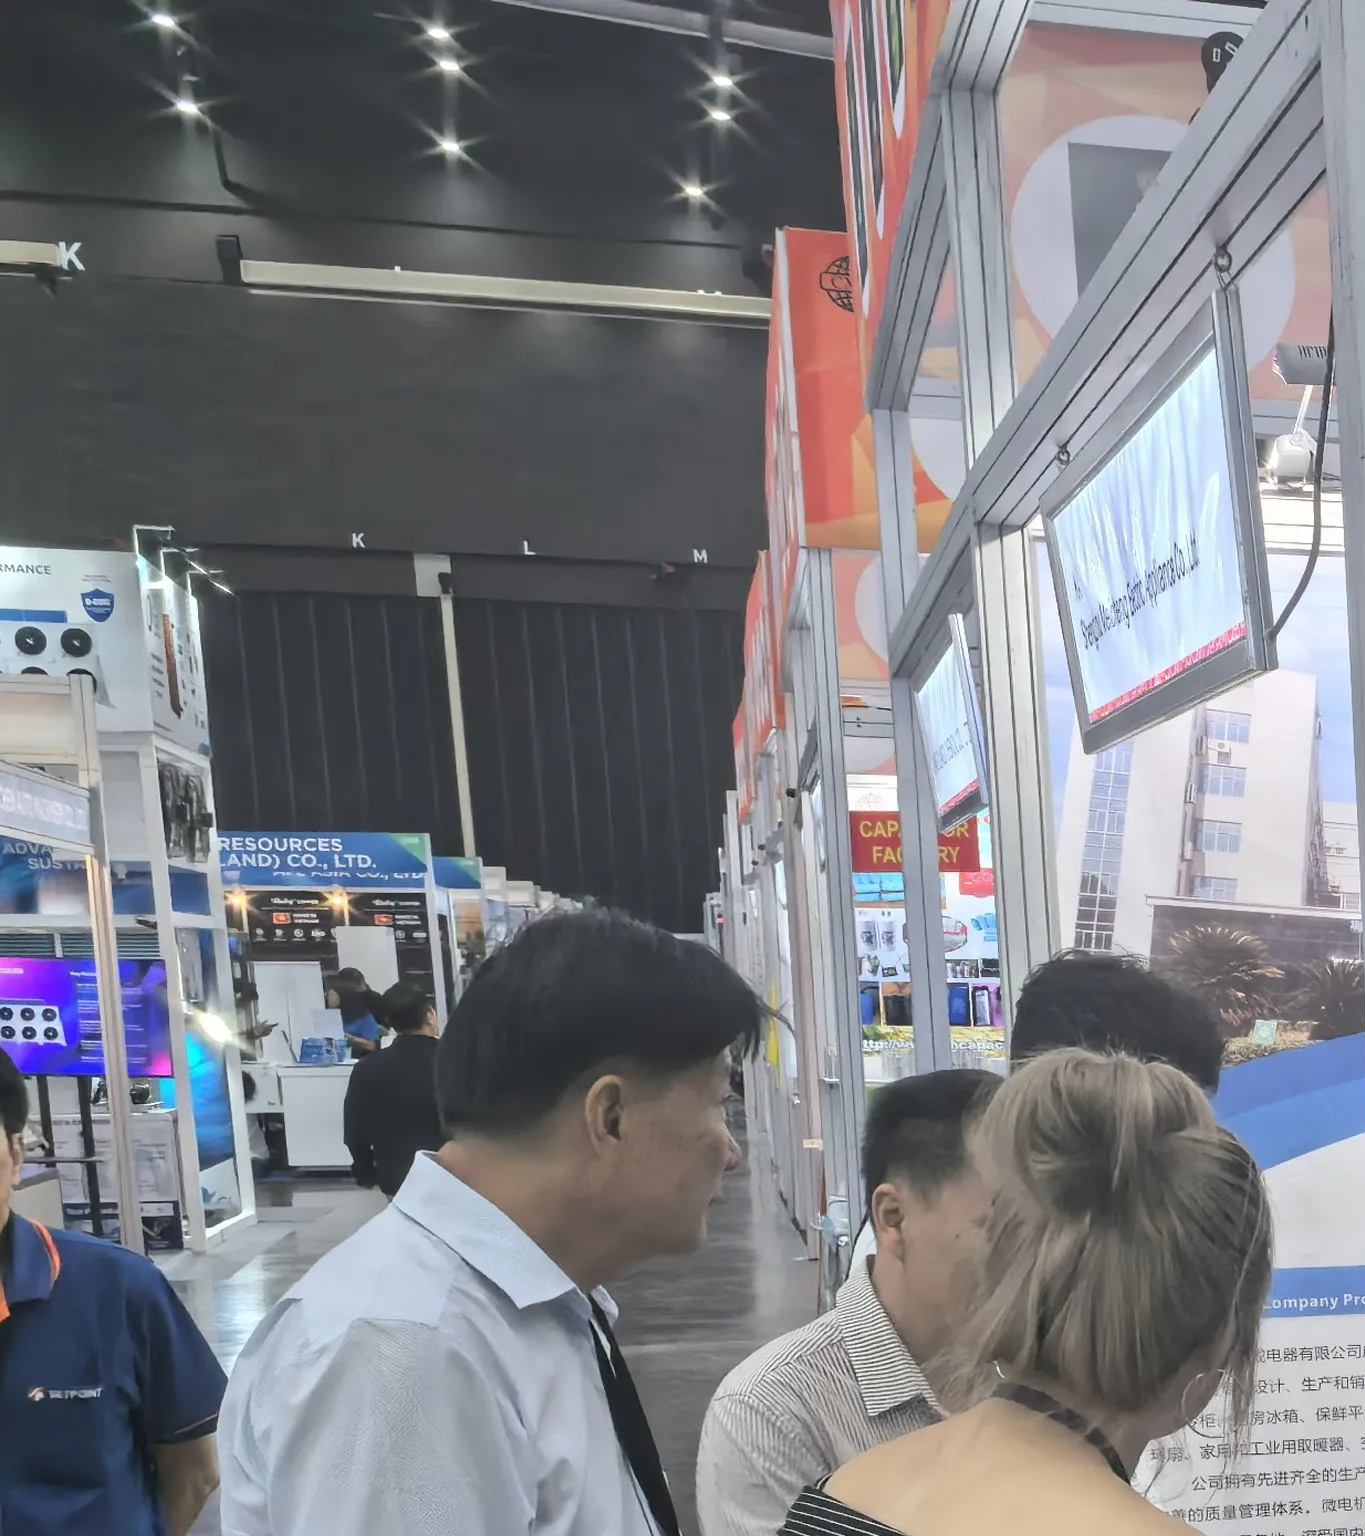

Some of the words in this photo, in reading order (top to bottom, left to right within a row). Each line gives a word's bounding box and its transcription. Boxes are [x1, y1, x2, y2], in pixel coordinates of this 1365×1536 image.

[58, 241, 84, 271] K
[352, 533, 365, 549] K
[524, 541, 535, 556] L
[693, 549, 707, 564] M
